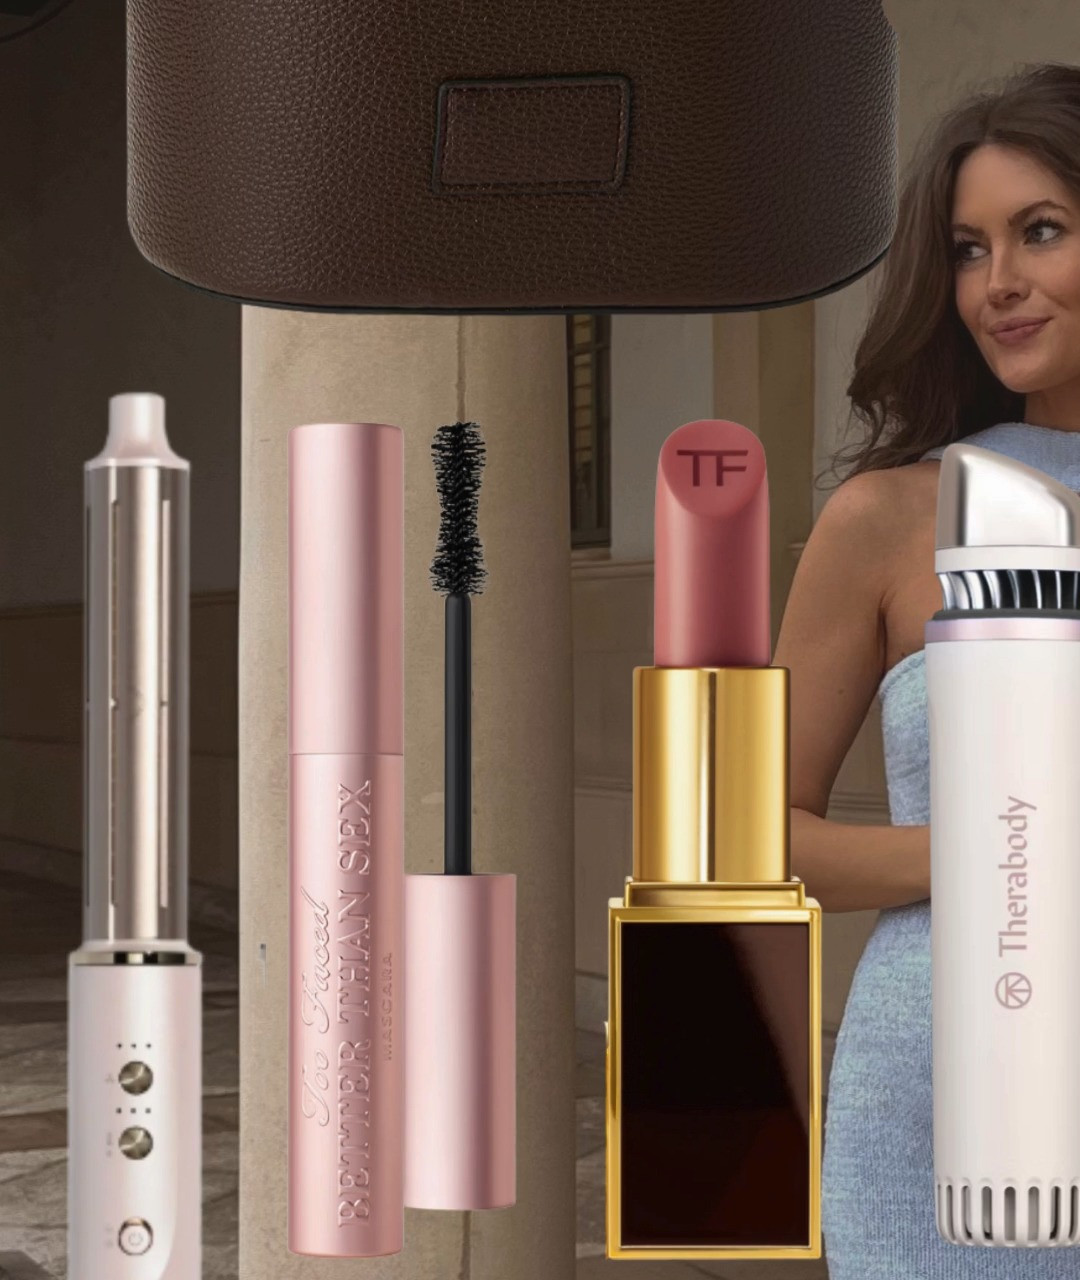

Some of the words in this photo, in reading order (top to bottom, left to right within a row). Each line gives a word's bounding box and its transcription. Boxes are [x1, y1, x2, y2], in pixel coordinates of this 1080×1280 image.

[676, 449, 749, 487] TF
[337, 780, 373, 876] SEX
[997, 795, 1038, 958] Therabody
[300, 886, 331, 1035] Faced
[337, 889, 372, 1024] THAN
[381, 951, 393, 1061] MASCARA
[301, 1048, 331, 1127] Too
[337, 1038, 372, 1228] BETTER
